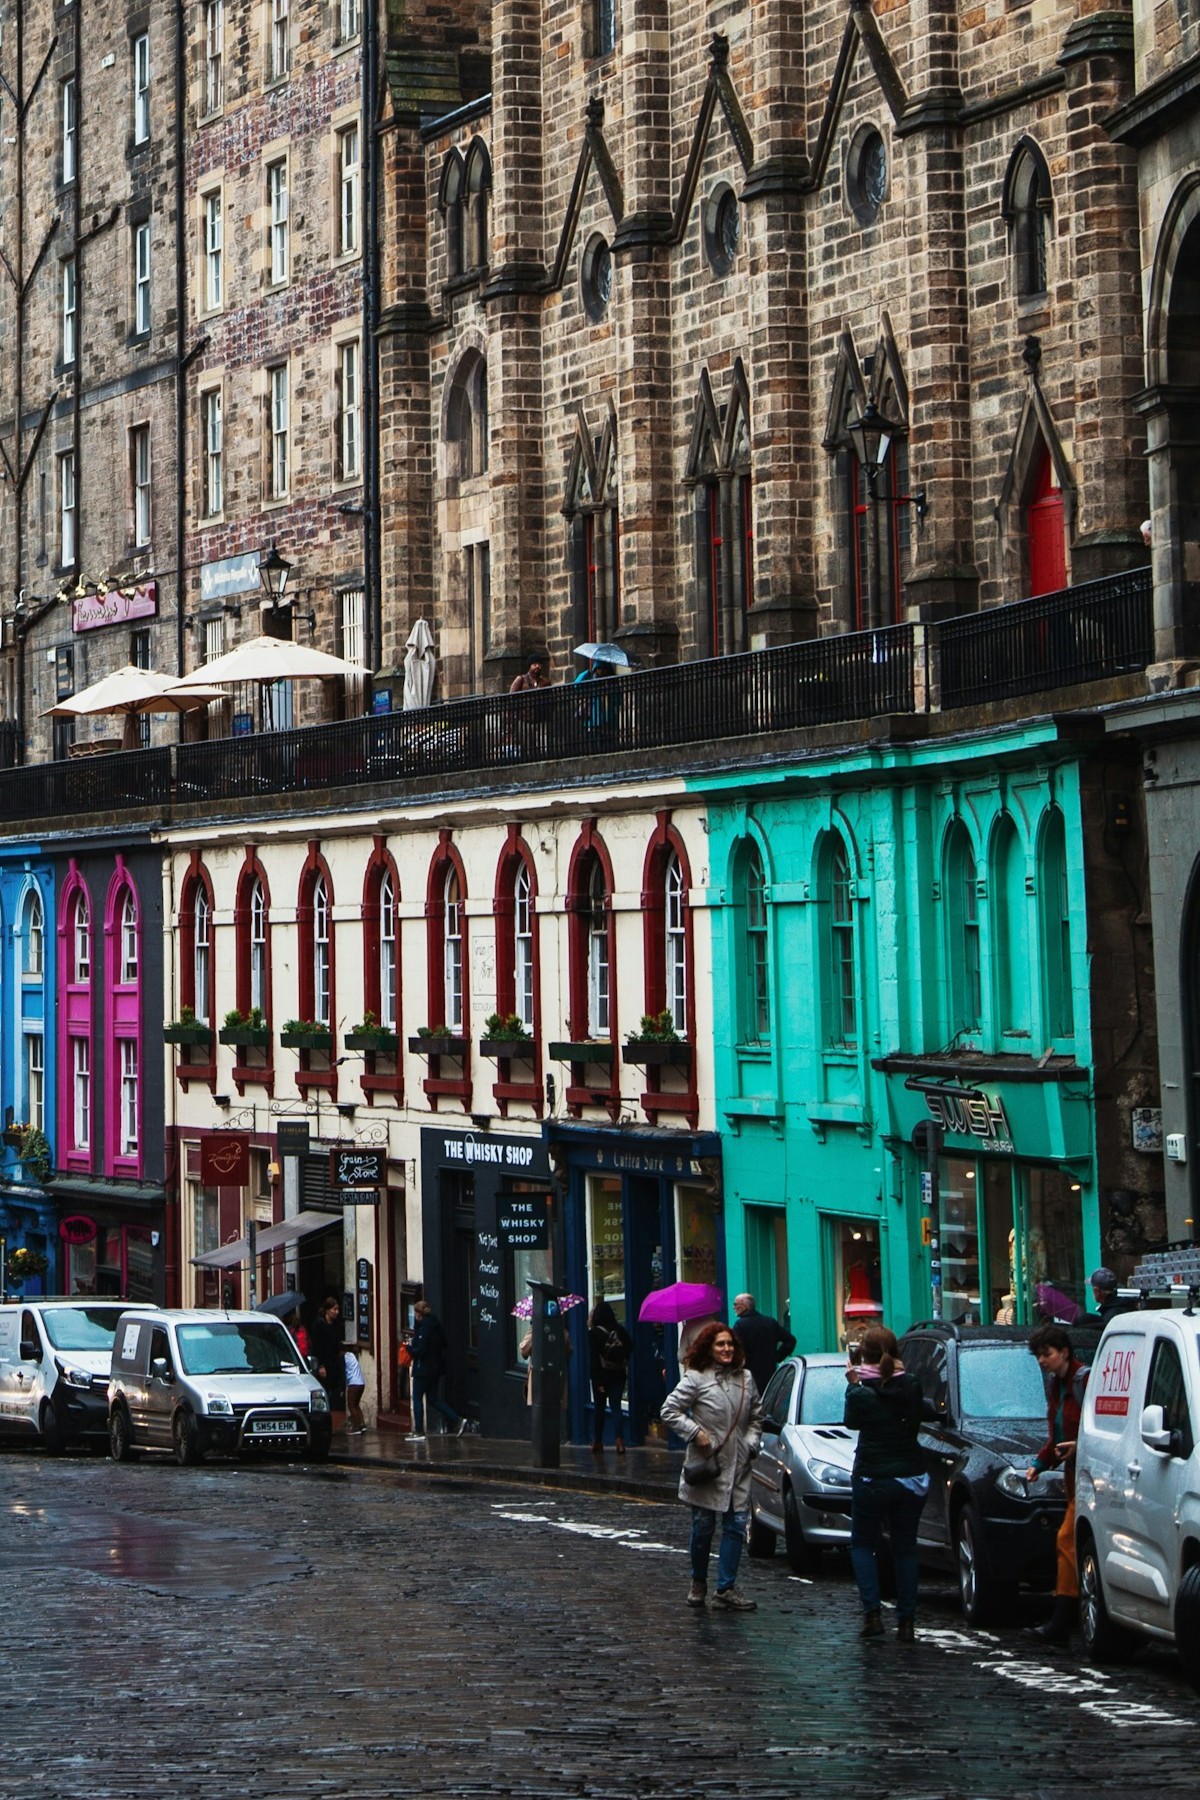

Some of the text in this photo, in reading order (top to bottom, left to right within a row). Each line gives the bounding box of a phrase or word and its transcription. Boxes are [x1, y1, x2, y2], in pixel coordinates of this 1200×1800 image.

[924, 1093, 1010, 1138] SWISH
[444, 1136, 533, 1166] THE WHISKY SHOP
[339, 1152, 370, 1172] Grain
[348, 1165, 378, 1184] Store
[340, 1192, 379, 1204] RESTAURANT
[511, 1203, 533, 1212] THE
[500, 1218, 545, 1228] WHISKY
[479, 1232, 488, 1247] Not
[508, 1235, 538, 1244] SHOP
[480, 1283, 499, 1308] Whisky
[1109, 1351, 1135, 1392] FMS
[278, 1422, 294, 1430] EHK
